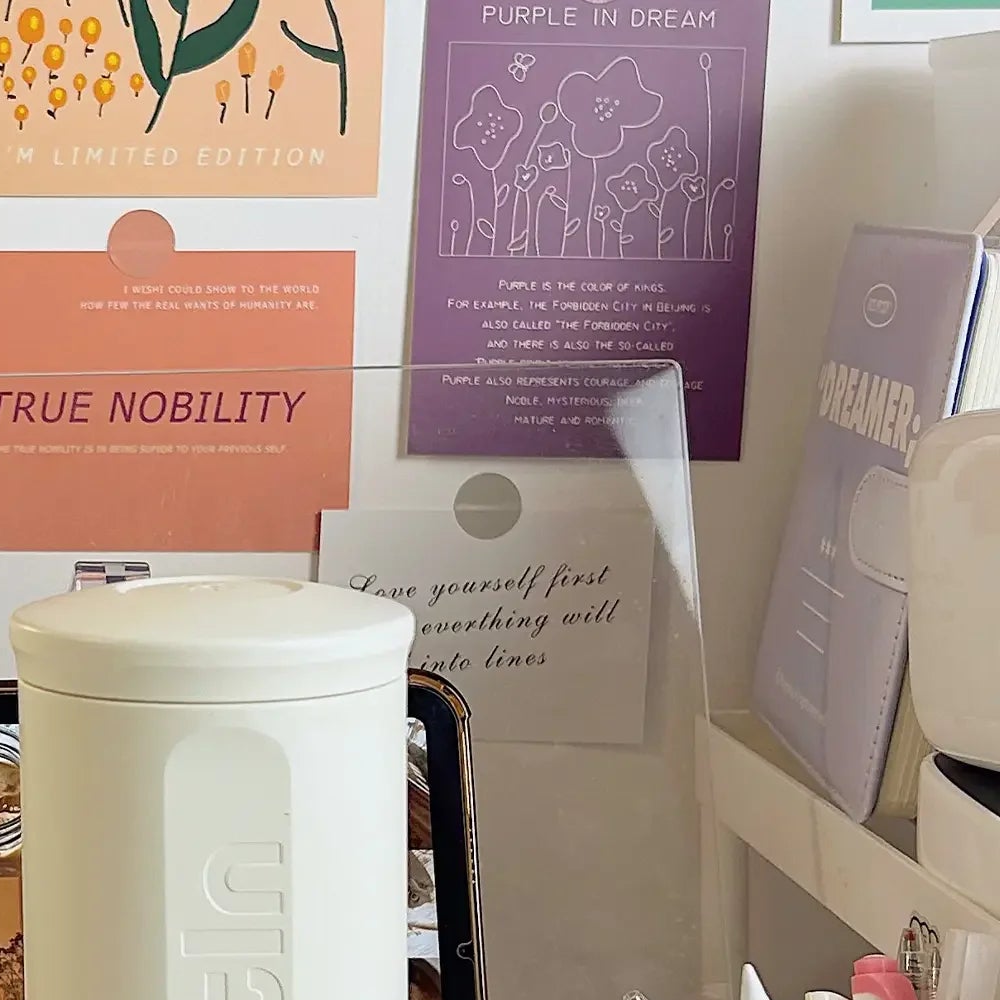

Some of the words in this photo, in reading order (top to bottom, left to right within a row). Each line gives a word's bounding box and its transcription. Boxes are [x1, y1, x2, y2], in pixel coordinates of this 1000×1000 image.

[482, 5, 577, 26] PURPLE
[593, 8, 617, 27] IN
[631, 8, 717, 28] DREAM
[53, 146, 179, 166] LIMITED
[198, 147, 325, 167] EDITION
[168, 285, 202, 294] COULD
[205, 285, 237, 294] SHOW
[240, 285, 254, 294] TO
[259, 285, 279, 294] THE
[282, 285, 320, 294] WORLD
[499, 280, 537, 292] PURPLE
[542, 281, 552, 292] IS
[557, 282, 576, 292] THE
[580, 282, 613, 293] COLOR
[617, 283, 630, 293] OF
[80, 301, 103, 310] HOW
[107, 301, 129, 310] FEW
[132, 301, 151, 310] THE
[155, 301, 180, 310] REAL
[184, 301, 218, 310] WANTS
[222, 301, 235, 310] OF
[239, 301, 292, 310] HUMANITY
[447, 298, 469, 309] FOR
[528, 301, 547, 311] THE
[552, 299, 608, 312] FORBIDDEN
[612, 301, 637, 313] CITY
[642, 302, 653, 312] IN
[656, 302, 696, 313] BEIJING
[701, 304, 712, 313] IS
[482, 319, 508, 330] ALSO
[512, 319, 551, 331] CALLED
[583, 319, 639, 332] FORBIDDEN
[487, 339, 508, 349] AND
[513, 339, 545, 350] THERE
[549, 340, 559, 350] IS
[564, 340, 590, 350] ALSO
[594, 340, 614, 351] THE
[618, 340, 674, 351] SO-CALLED
[442, 375, 481, 387] PURPLE
[485, 376, 512, 386] ALSO
[516, 376, 580, 388] REPRESENTS
[583, 376, 630, 388] COURAGE
[109, 391, 306, 423] NOBILITY
[514, 415, 555, 426] MATURE
[560, 416, 581, 426] AND
[428, 564, 546, 607] yourself
[544, 562, 612, 599] first
[420, 606, 552, 639] everthing
[562, 599, 621, 626] will
[419, 652, 472, 674] into
[485, 644, 546, 670] lines
